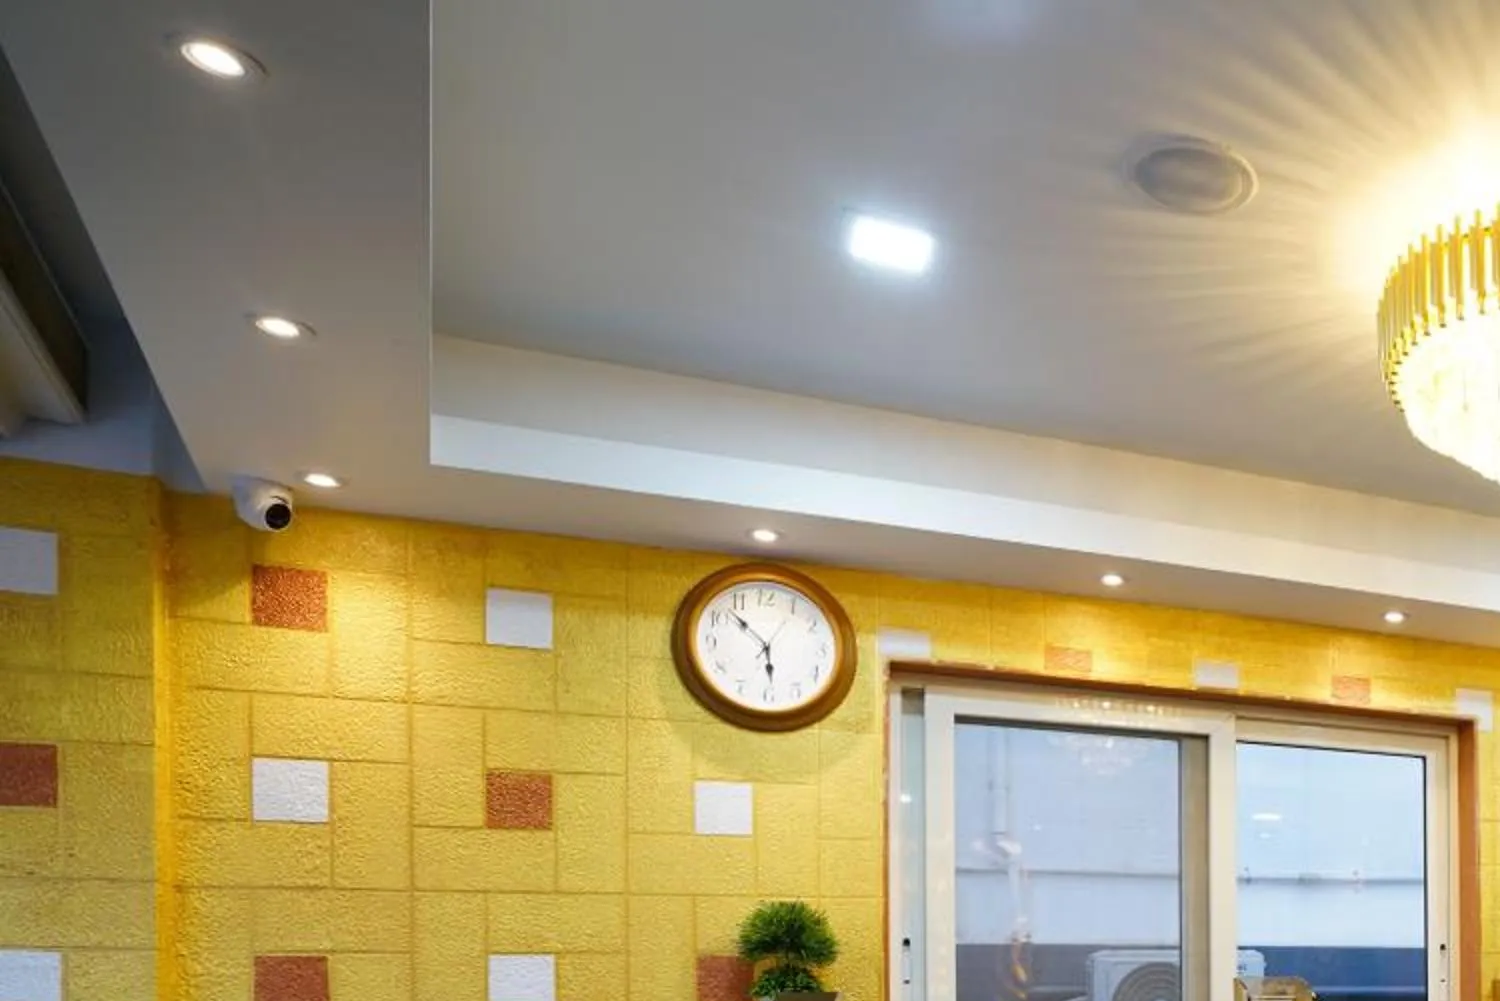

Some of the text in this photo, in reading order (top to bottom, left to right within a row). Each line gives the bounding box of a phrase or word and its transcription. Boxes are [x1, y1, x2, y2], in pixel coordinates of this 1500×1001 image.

[733, 592, 745, 611] 11
[757, 588, 776, 607] 12
[789, 596, 797, 615] 1
[711, 610, 729, 628] 10
[808, 618, 818, 634] 2
[705, 634, 717, 652] 9
